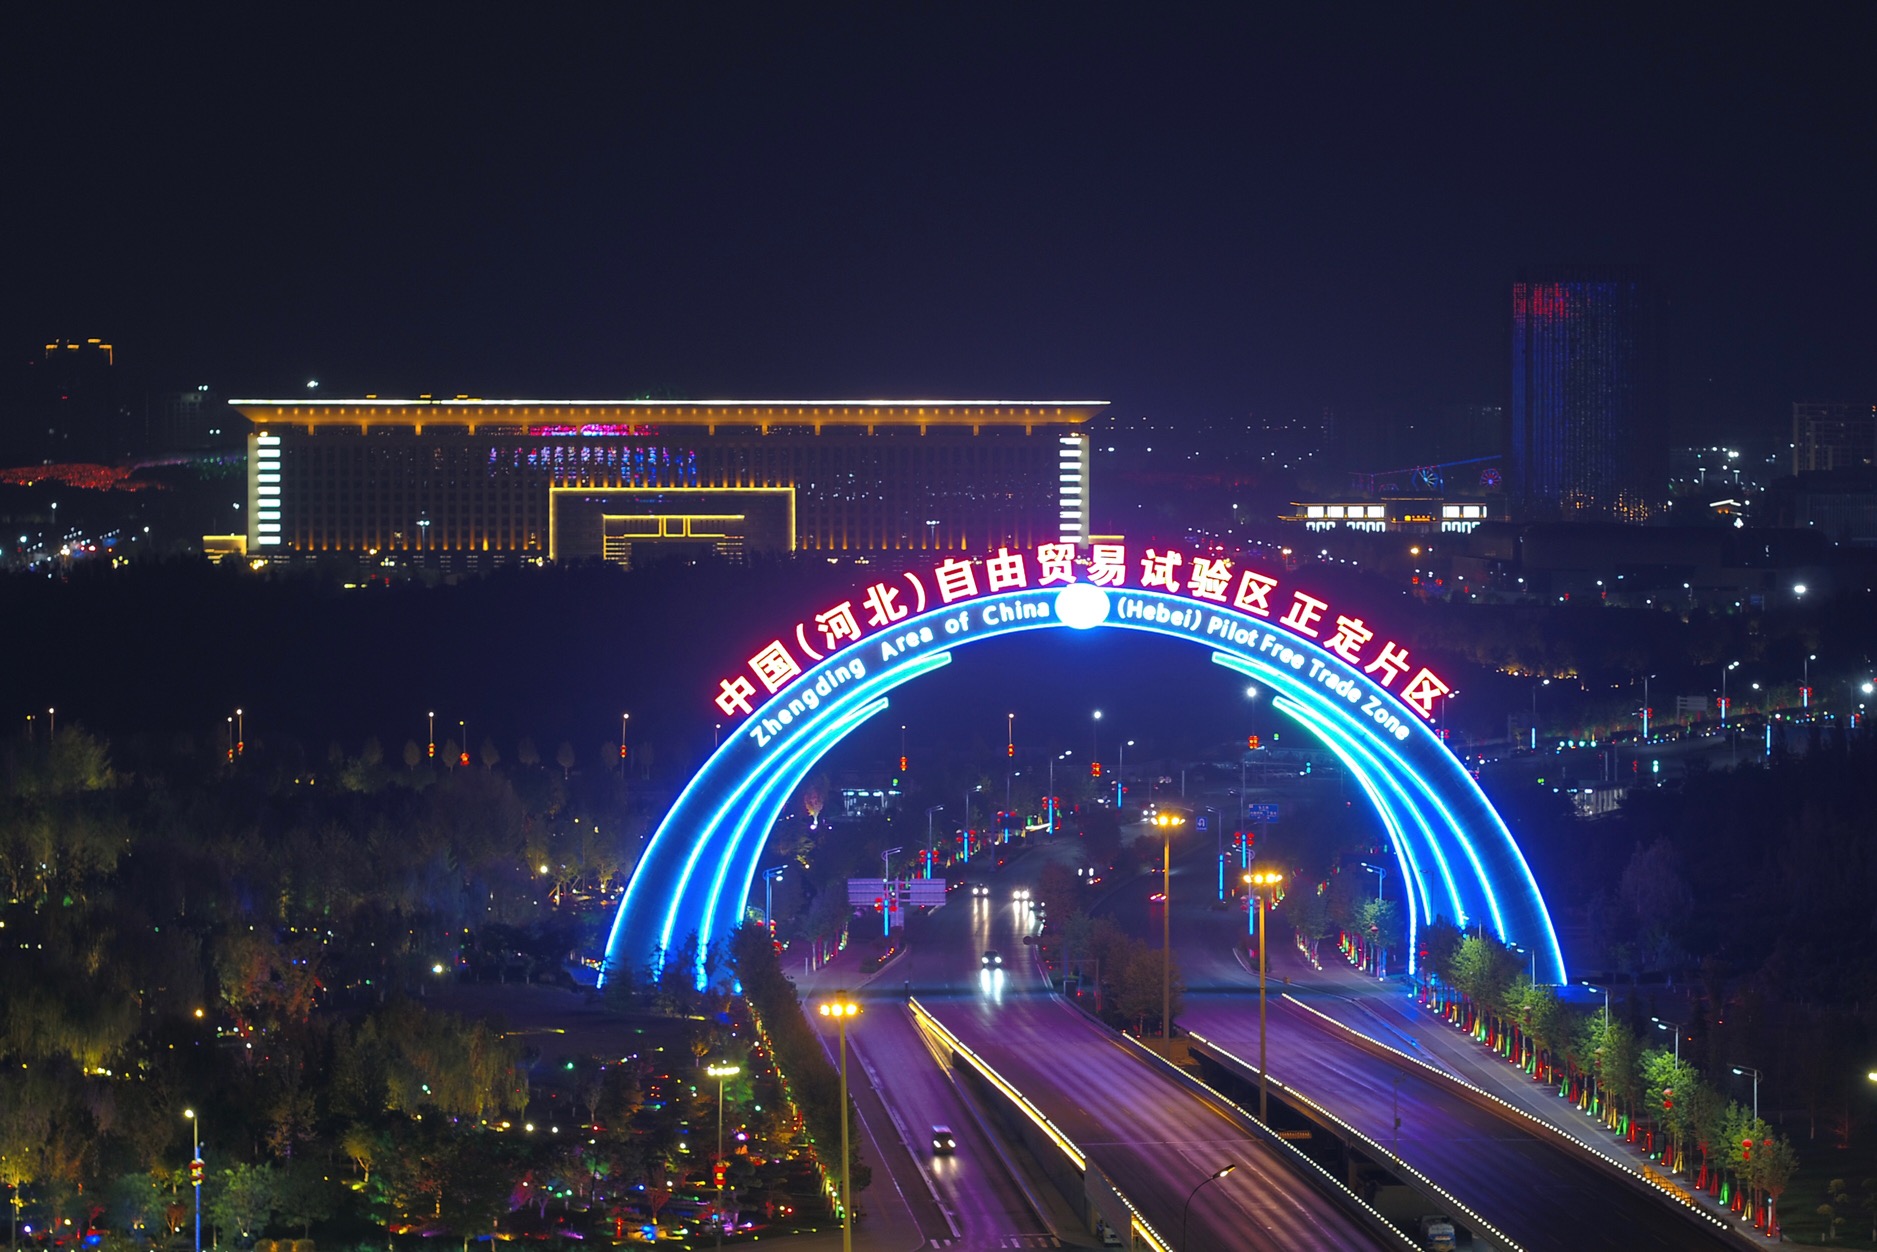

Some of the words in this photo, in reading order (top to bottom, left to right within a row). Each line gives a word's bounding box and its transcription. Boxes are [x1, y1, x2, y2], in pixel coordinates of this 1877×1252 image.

[750, 656, 866, 748] Zhengding
[880, 625, 934, 662] Area
[944, 611, 969, 634] of
[982, 600, 1050, 626] China
[1117, 596, 1201, 631] (Hebei)
[1207, 616, 1258, 647] Pilot
[1259, 634, 1305, 671] Free
[1308, 657, 1362, 704] Trade
[1360, 695, 1410, 741] Zone
